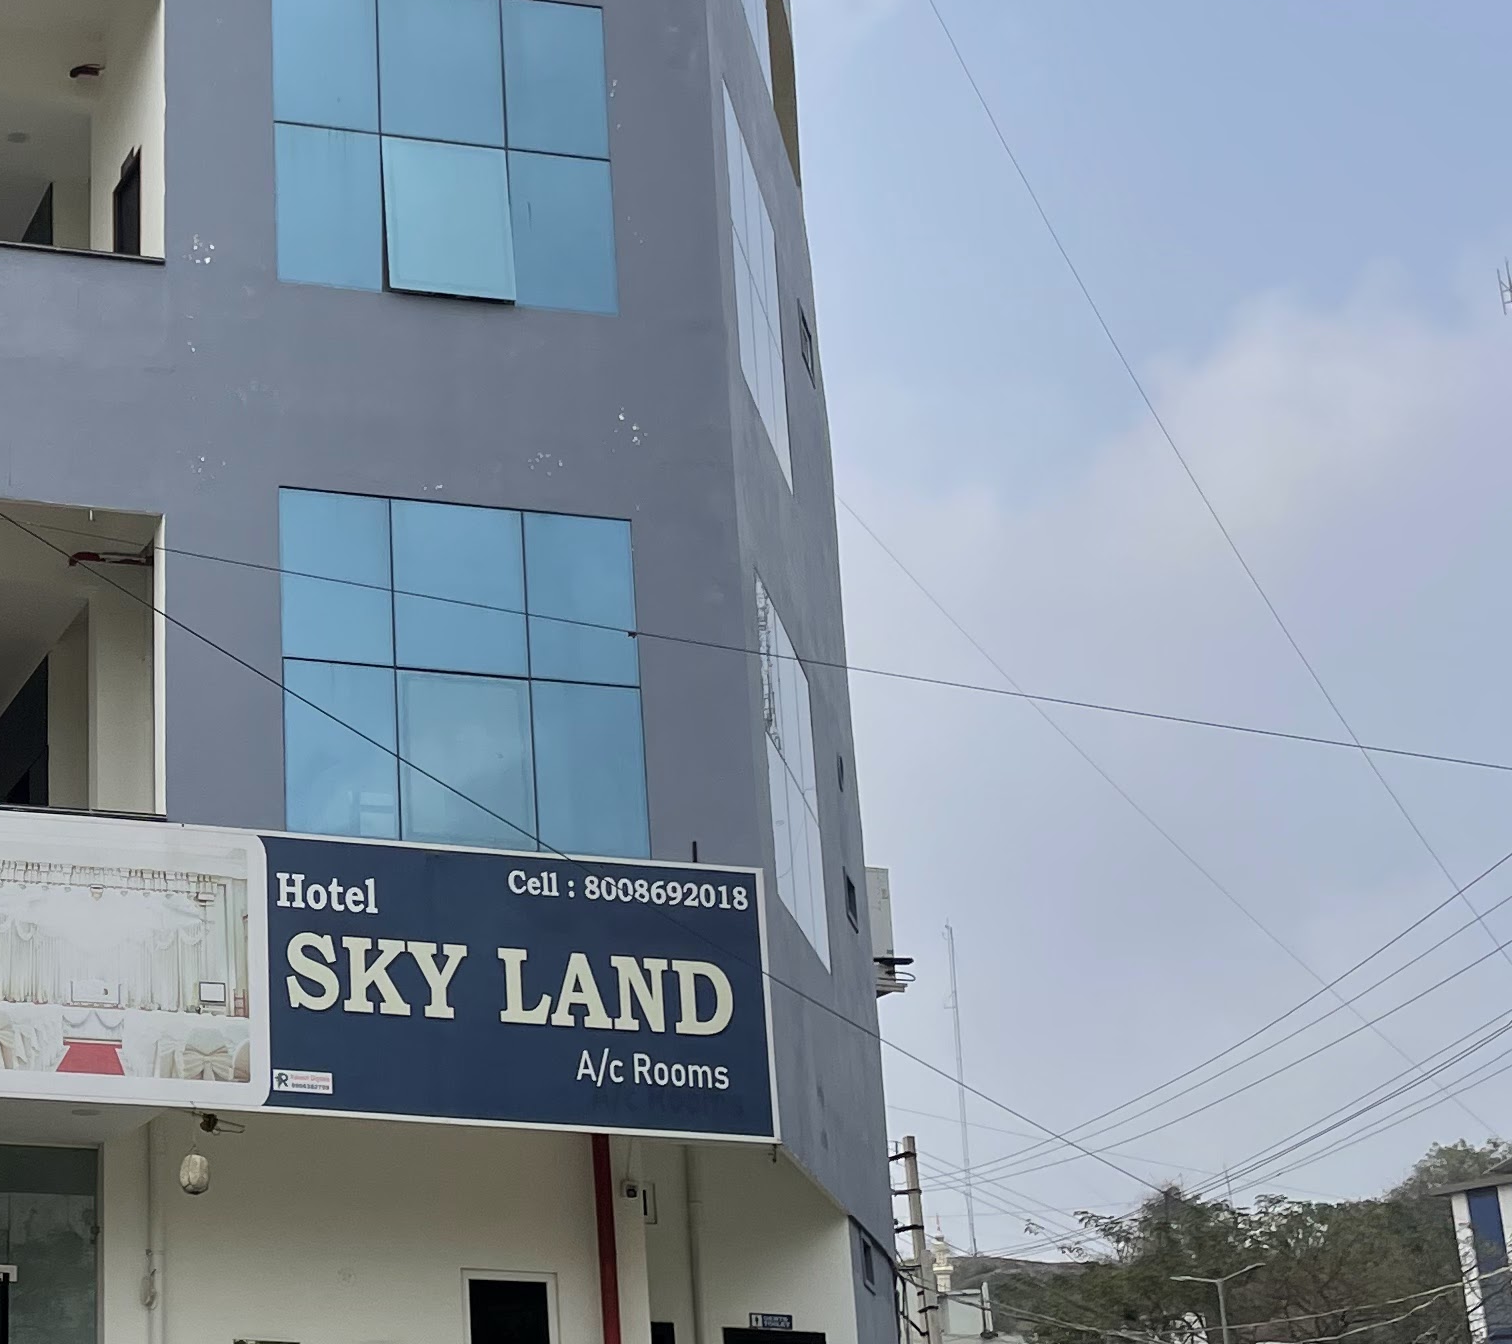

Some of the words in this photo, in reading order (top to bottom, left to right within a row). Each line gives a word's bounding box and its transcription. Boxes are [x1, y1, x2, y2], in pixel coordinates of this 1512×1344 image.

[275, 872, 379, 915] Hotel
[507, 869, 560, 898] Cell
[584, 874, 749, 912] 8008692018
[287, 931, 468, 1020] SKY
[498, 945, 734, 1037] LAND
[576, 1048, 626, 1086] A/c
[633, 1054, 730, 1092] Rooms
